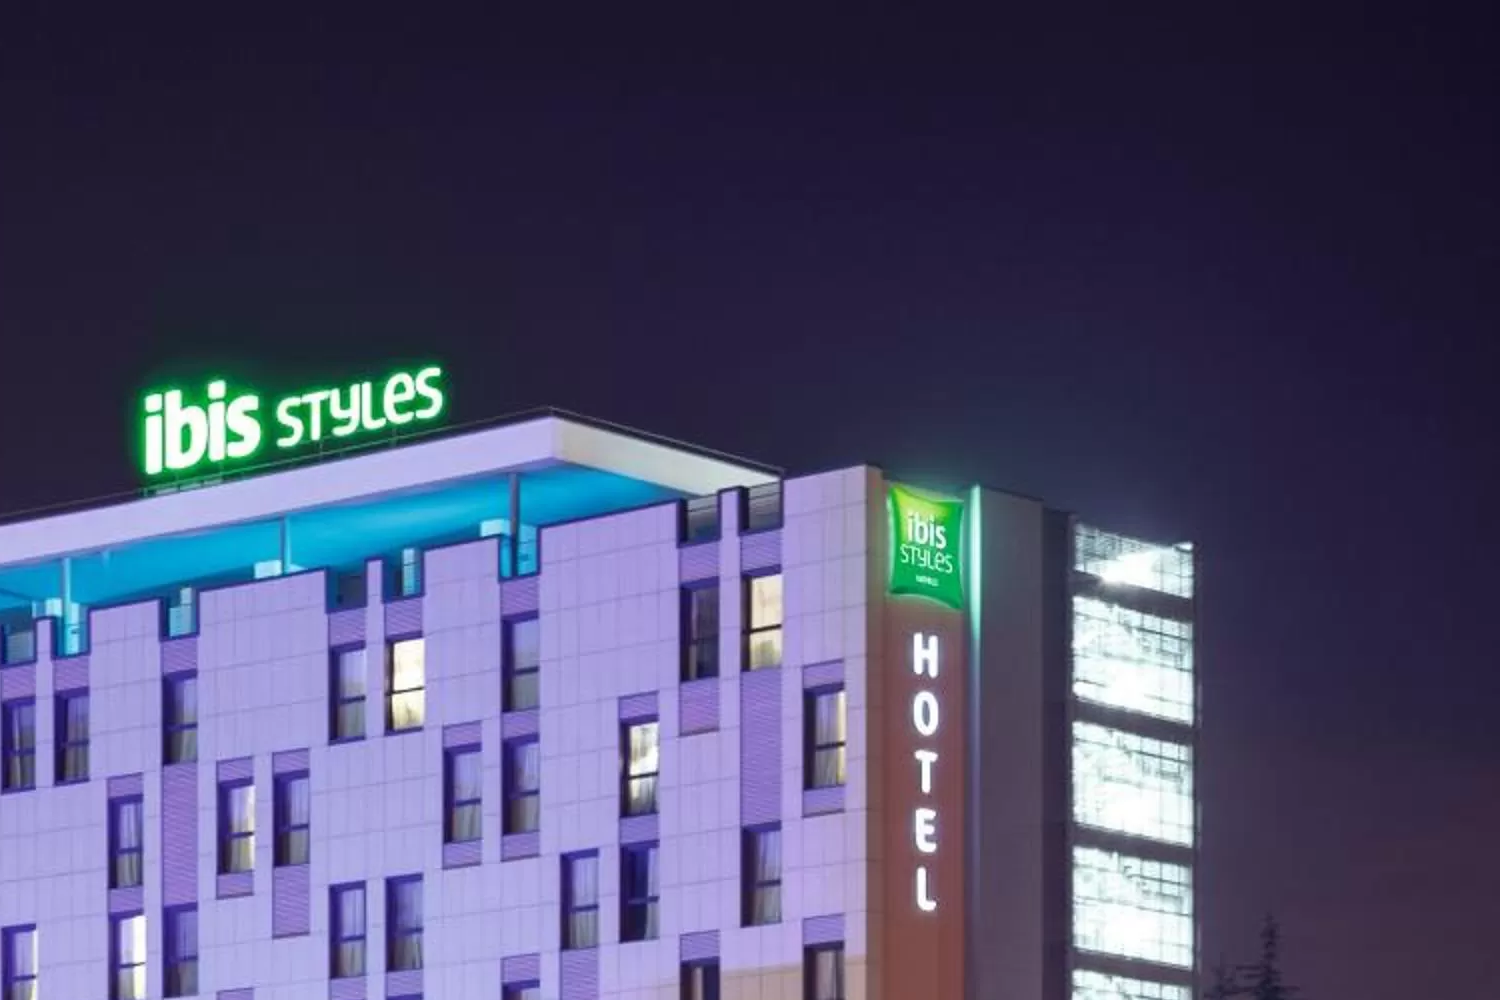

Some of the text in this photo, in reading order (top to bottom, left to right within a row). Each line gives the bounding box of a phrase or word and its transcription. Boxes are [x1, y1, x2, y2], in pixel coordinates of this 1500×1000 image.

[145, 379, 261, 475] ibis
[907, 511, 947, 549] ibis
[913, 632, 939, 912] HOTEL
